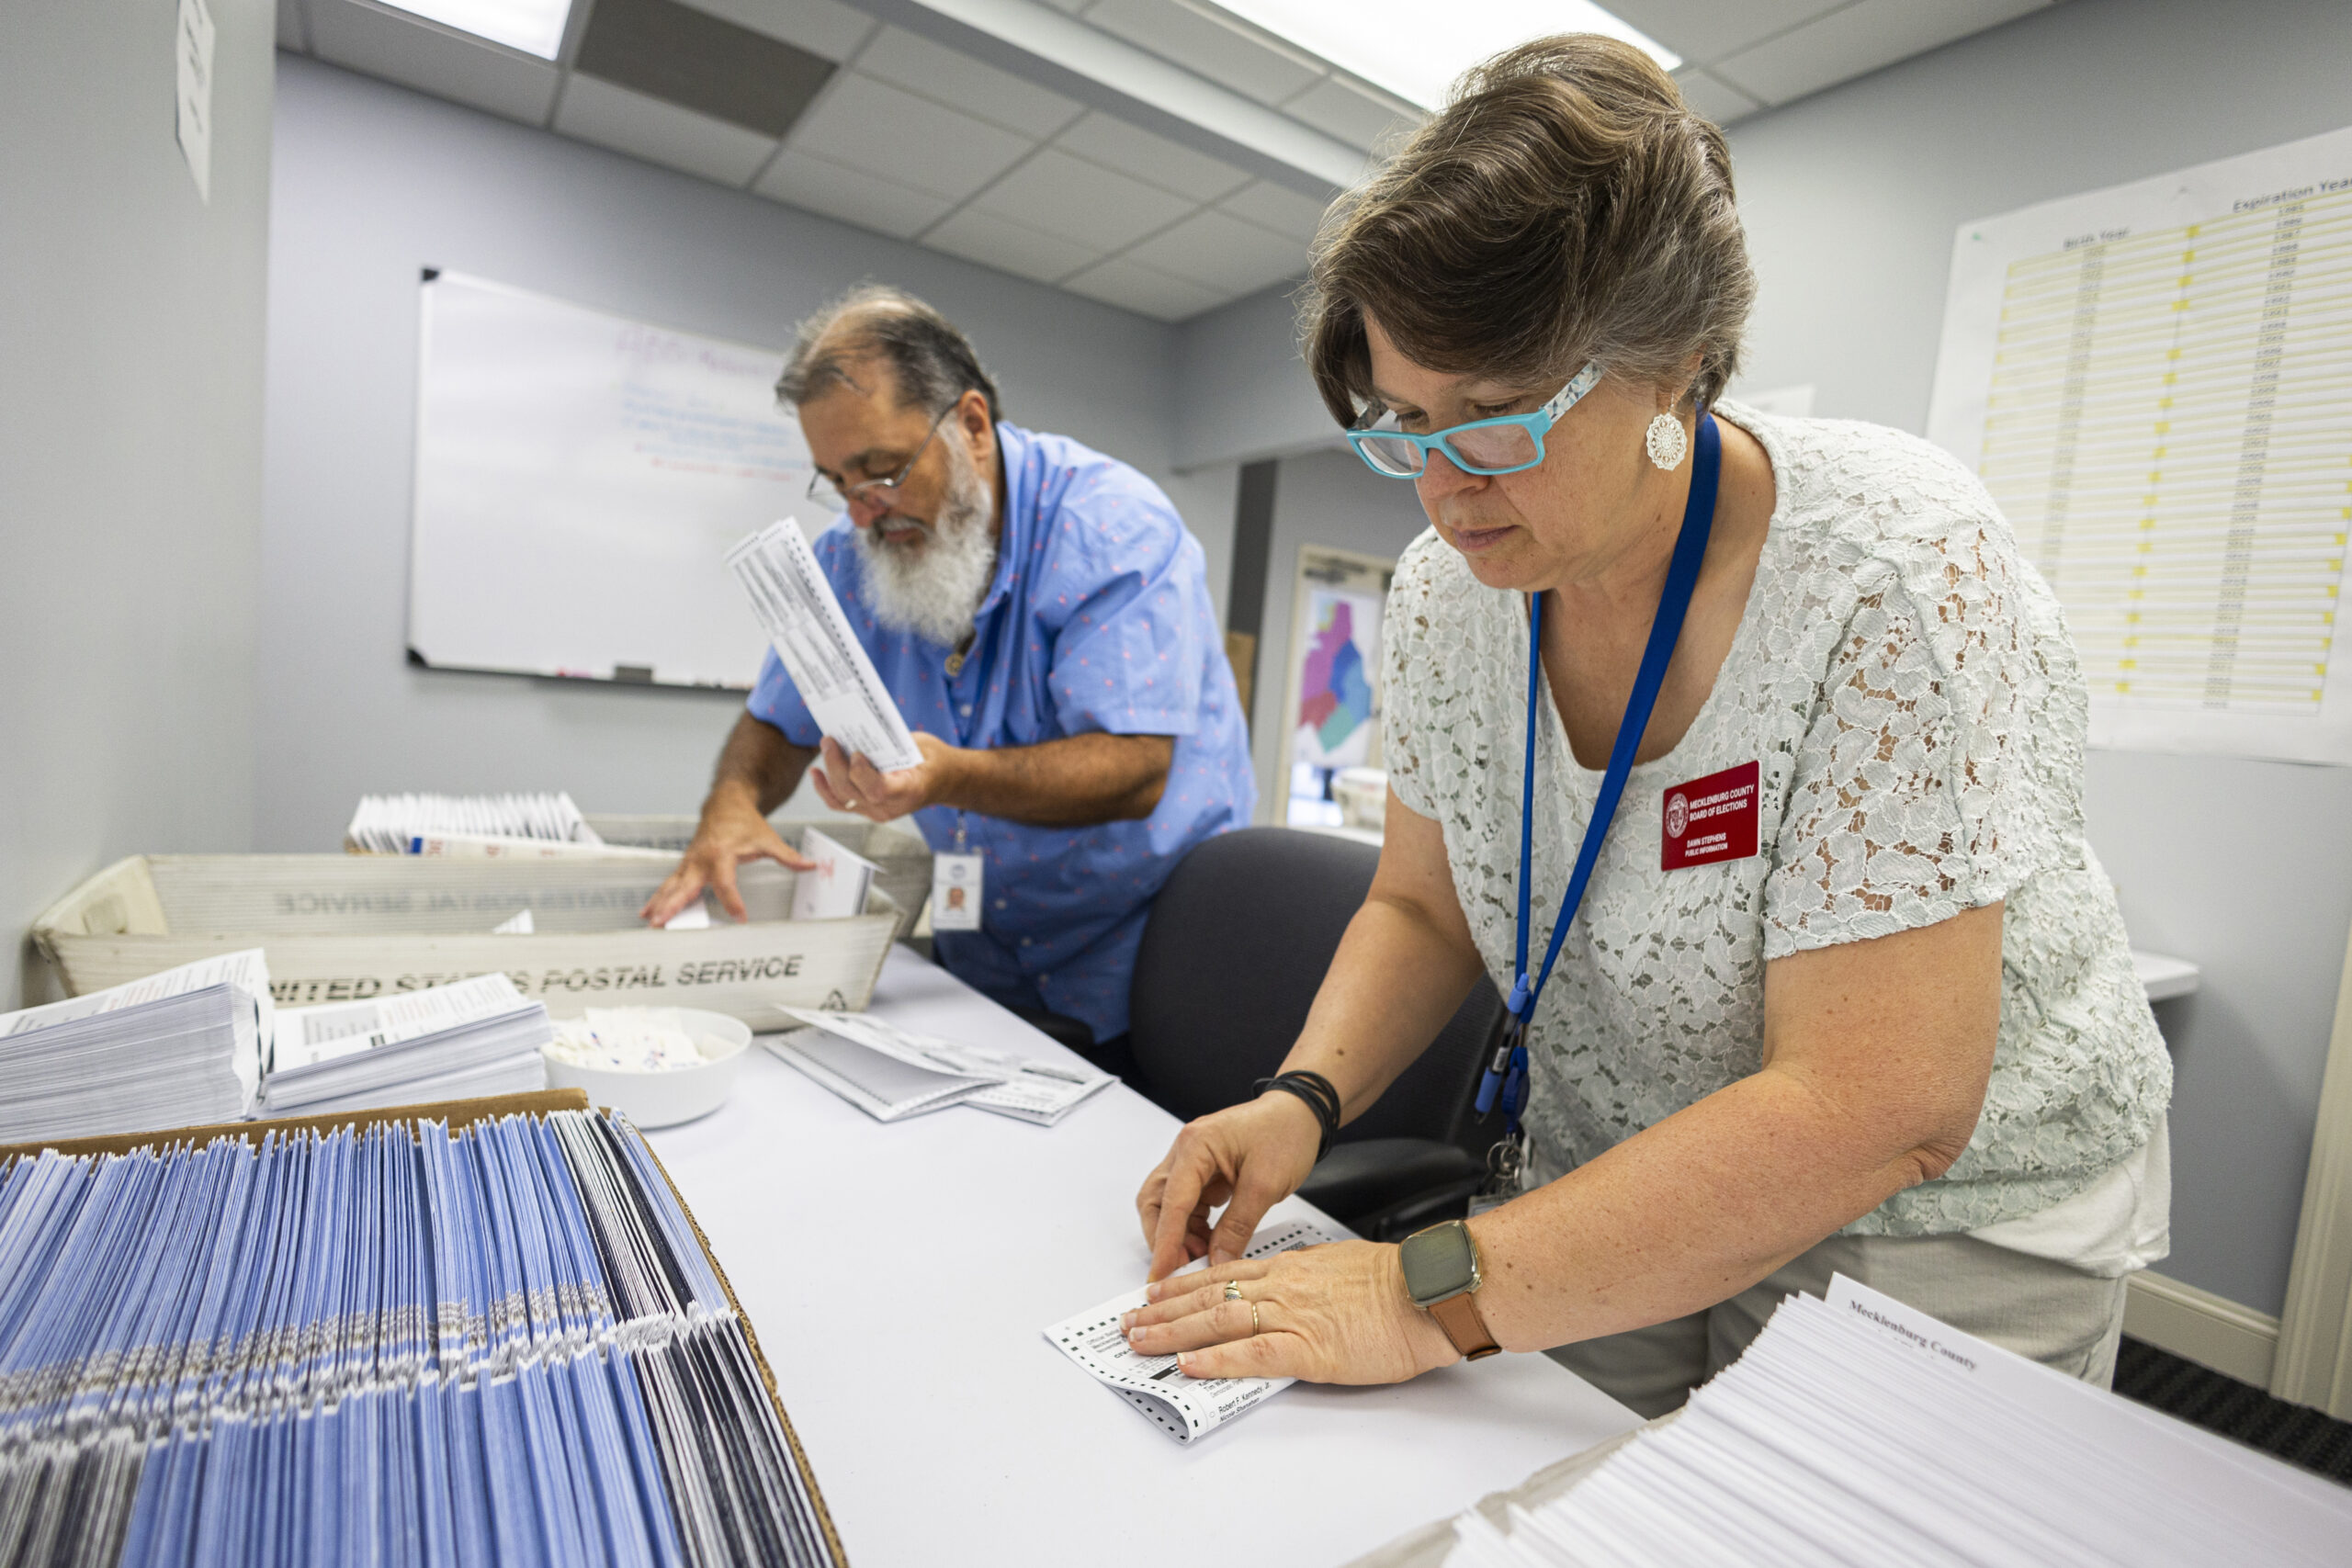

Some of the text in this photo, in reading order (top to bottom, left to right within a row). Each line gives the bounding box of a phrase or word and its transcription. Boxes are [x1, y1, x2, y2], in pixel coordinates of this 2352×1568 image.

[2233, 176, 2352, 213] Expiration Yea
[1690, 784, 1755, 809] MECKLENBURG COUNTY
[1690, 798, 1747, 822] BOARD OF ELECTIONS
[1685, 842, 1728, 858] PUBLIC INFORMATION
[1687, 832, 1726, 849] DAWN STEPHENS
[268, 976, 381, 1002] NITED
[539, 964, 666, 993] POSTAL
[676, 954, 804, 986] SERVICE
[1849, 1299, 1977, 1372] Mecklenburg County
[1204, 1384, 1216, 1393] Tim
[1218, 1400, 1236, 1415] Robert
[1235, 1396, 1243, 1405] F.
[1242, 1386, 1265, 1402] Kennedy,
[1219, 1396, 1260, 1423] Nicole Shanahan
